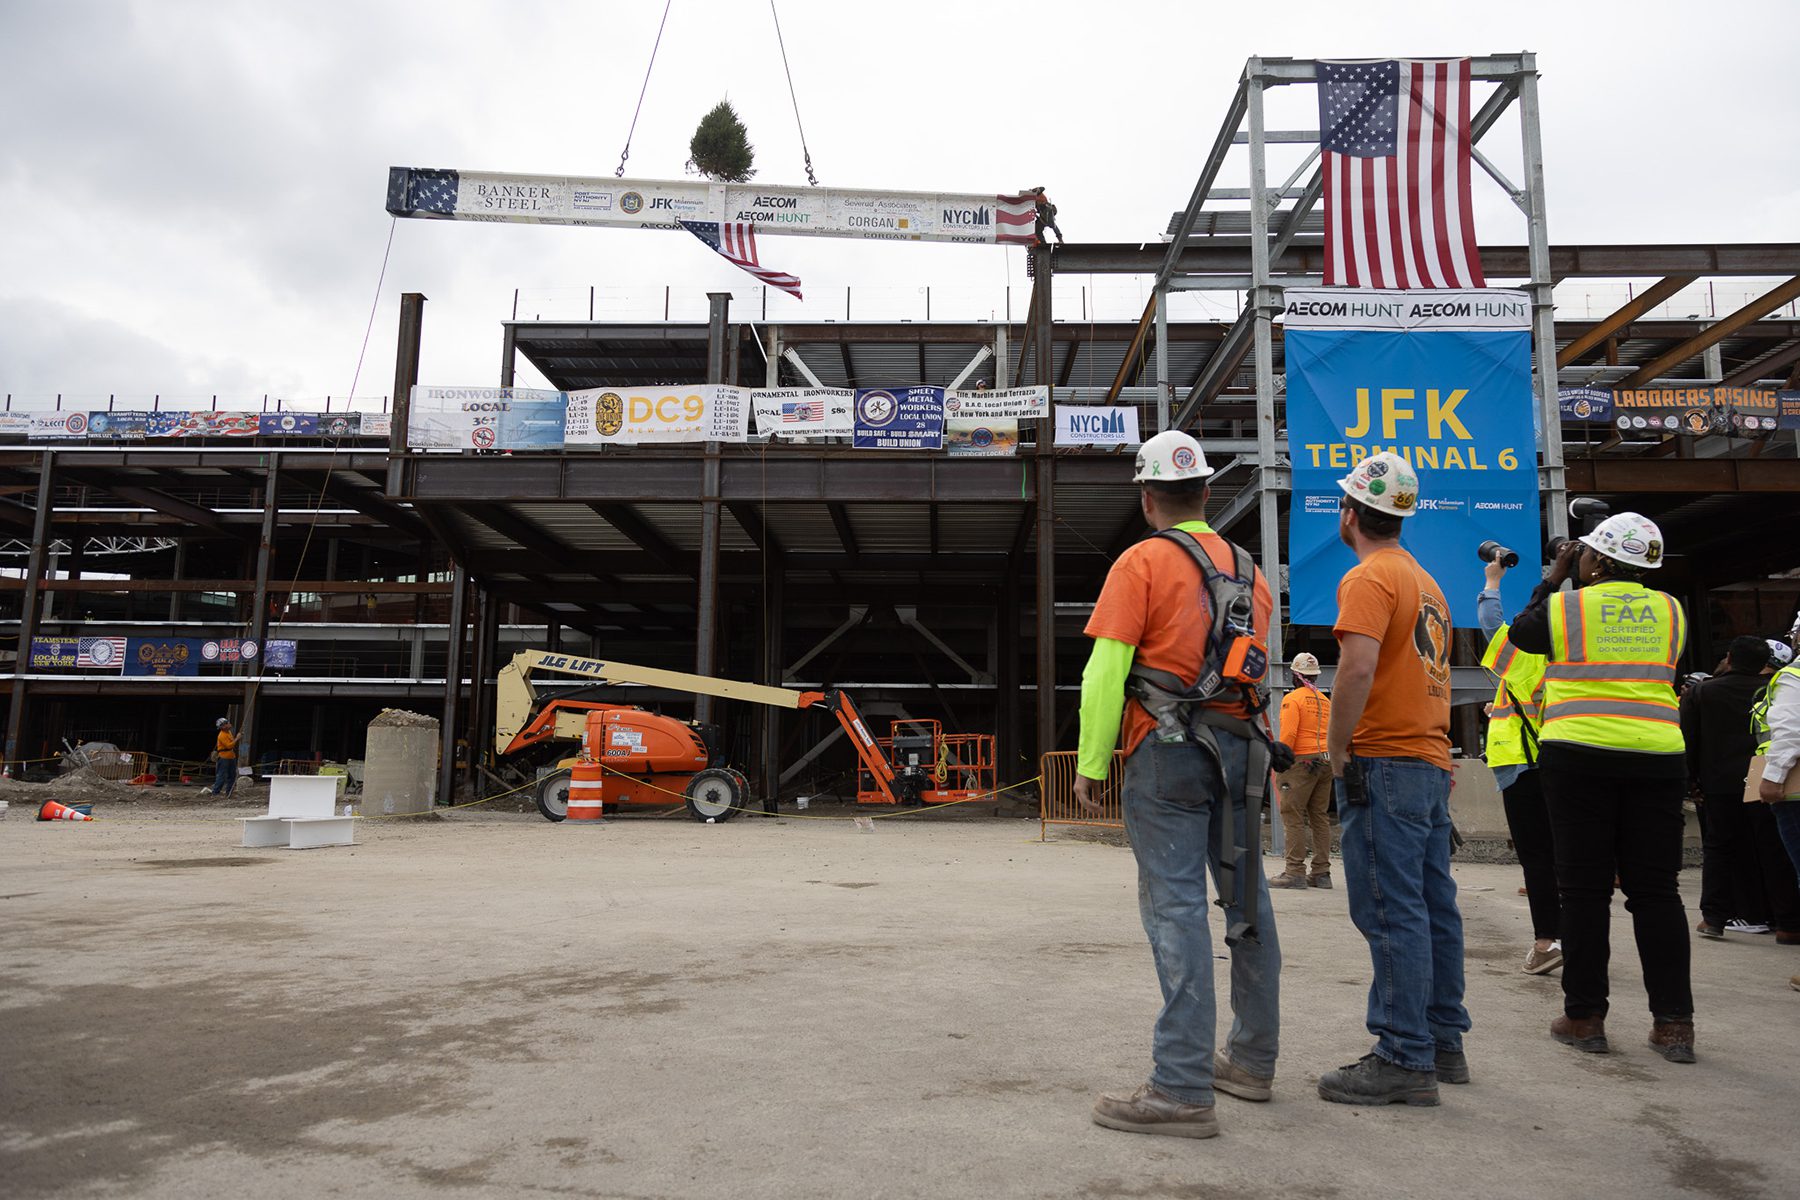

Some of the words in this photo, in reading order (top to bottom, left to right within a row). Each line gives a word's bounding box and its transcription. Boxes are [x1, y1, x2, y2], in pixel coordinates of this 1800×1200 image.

[477, 184, 550, 198] BANKER
[485, 197, 541, 211] STEEL
[649, 198, 673, 210] JFK
[752, 196, 797, 209] AECOM
[844, 199, 875, 208] Severud
[878, 201, 918, 210] Associates
[736, 211, 774, 222] AECOM
[776, 213, 811, 224] HUNT
[848, 216, 895, 228] CORGAN
[640, 222, 683, 231] AECOM
[863, 232, 907, 240] CORGAN
[1286, 301, 1347, 317] AECOM
[1351, 302, 1404, 318] HUNT
[1409, 302, 1471, 318] AECOM
[1474, 302, 1528, 317] HUNT
[428, 389, 545, 400] IRONWORKERS
[752, 390, 799, 398] ORNAMENTAL
[803, 389, 853, 397] IRONWORKERS
[1009, 389, 1036, 397] Terrazzo
[1612, 389, 1712, 408] LABORERS
[1713, 387, 1777, 409] RISING
[461, 402, 511, 412] LOCAL
[900, 404, 942, 412] WORKERS
[984, 400, 1002, 408] Local
[1003, 399, 1022, 407] Union
[628, 395, 705, 423] DC9
[831, 407, 846, 415] 580
[1345, 387, 1474, 440] JFK
[922, 413, 942, 421] UNION
[908, 430, 940, 438] SMART
[877, 439, 898, 447] BUILD
[899, 439, 922, 447] UNION
[1176, 454, 1192, 464] 79
[1497, 448, 1519, 471] 6
[1418, 499, 1438, 510] JFK
[1474, 502, 1500, 510] AECOM
[1601, 604, 1658, 623] FAA
[1604, 625, 1656, 634] CERTIFIED
[1596, 636, 1633, 644] DRONE
[1635, 636, 1663, 644] PILOT
[538, 655, 569, 669] JLG
[569, 659, 605, 674] LIFT
[606, 749, 631, 757] 600AJ
